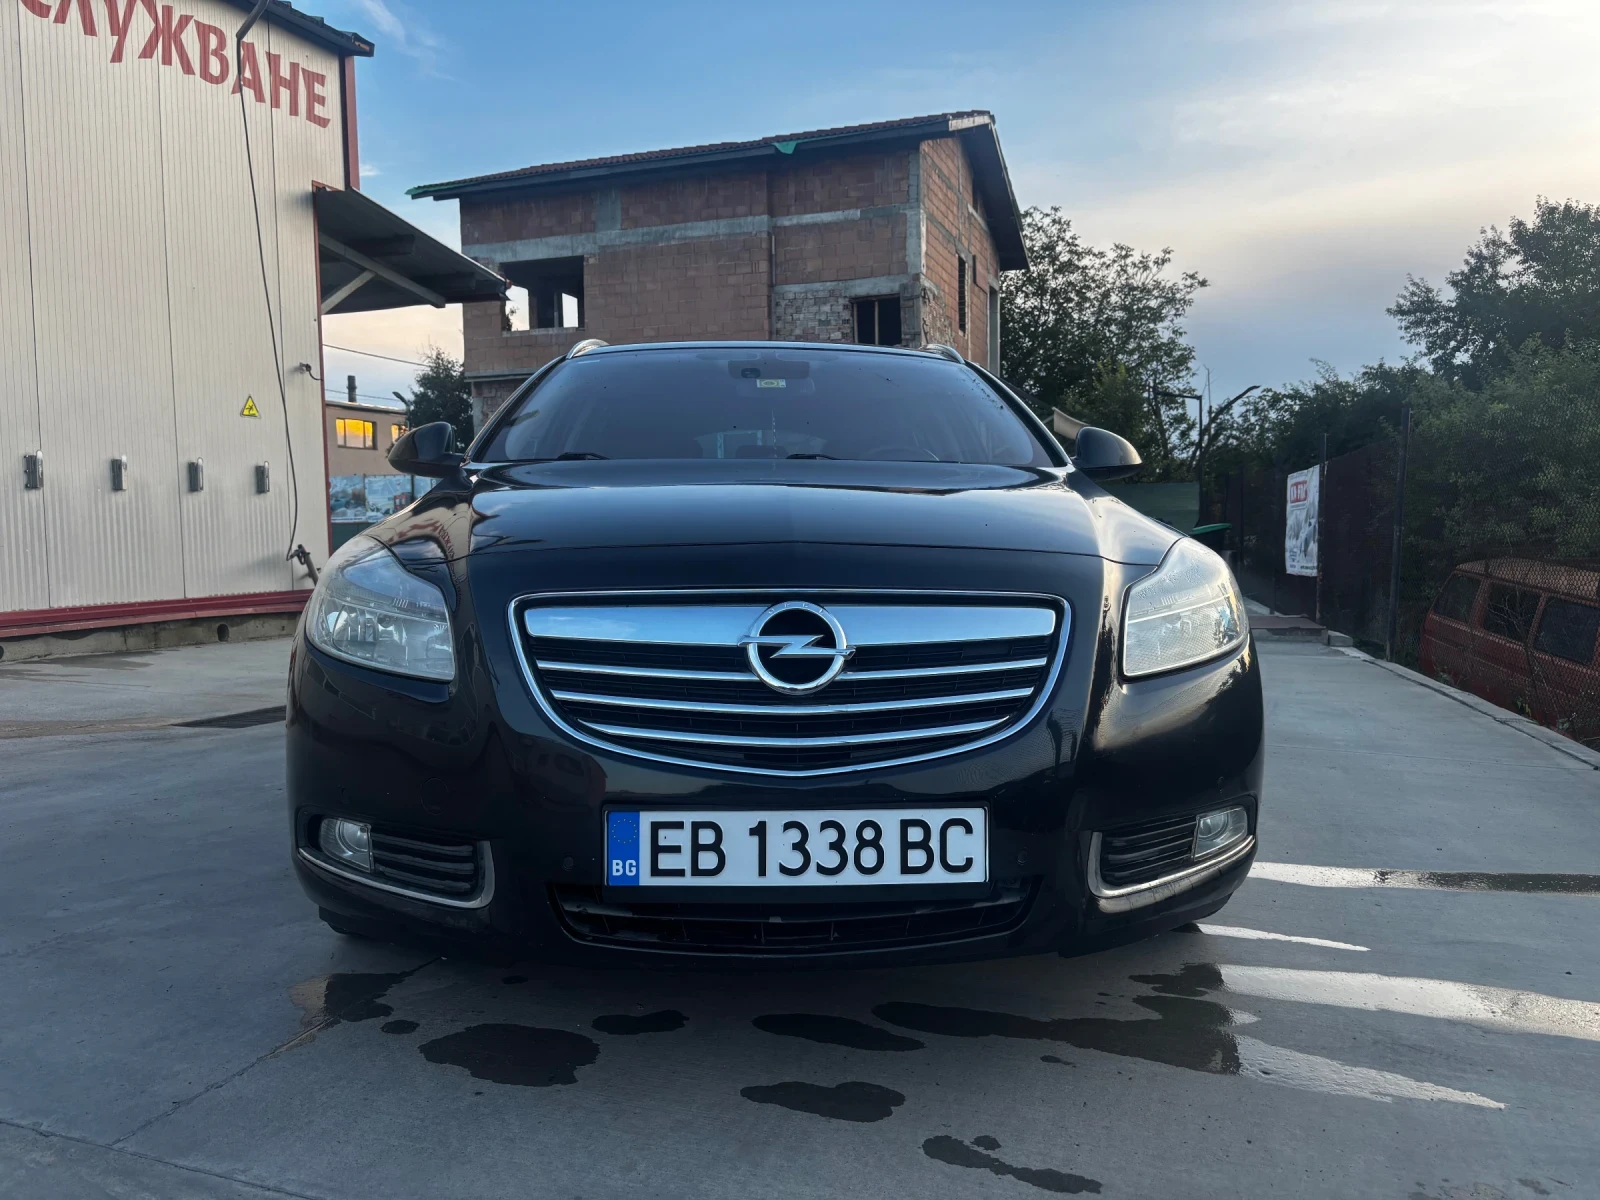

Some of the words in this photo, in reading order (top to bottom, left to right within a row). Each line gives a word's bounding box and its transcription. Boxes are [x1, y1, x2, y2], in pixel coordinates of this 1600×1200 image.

[649, 820, 726, 877] EB
[748, 819, 885, 877] 1338
[899, 818, 974, 875] BC
[612, 859, 637, 876] BG
